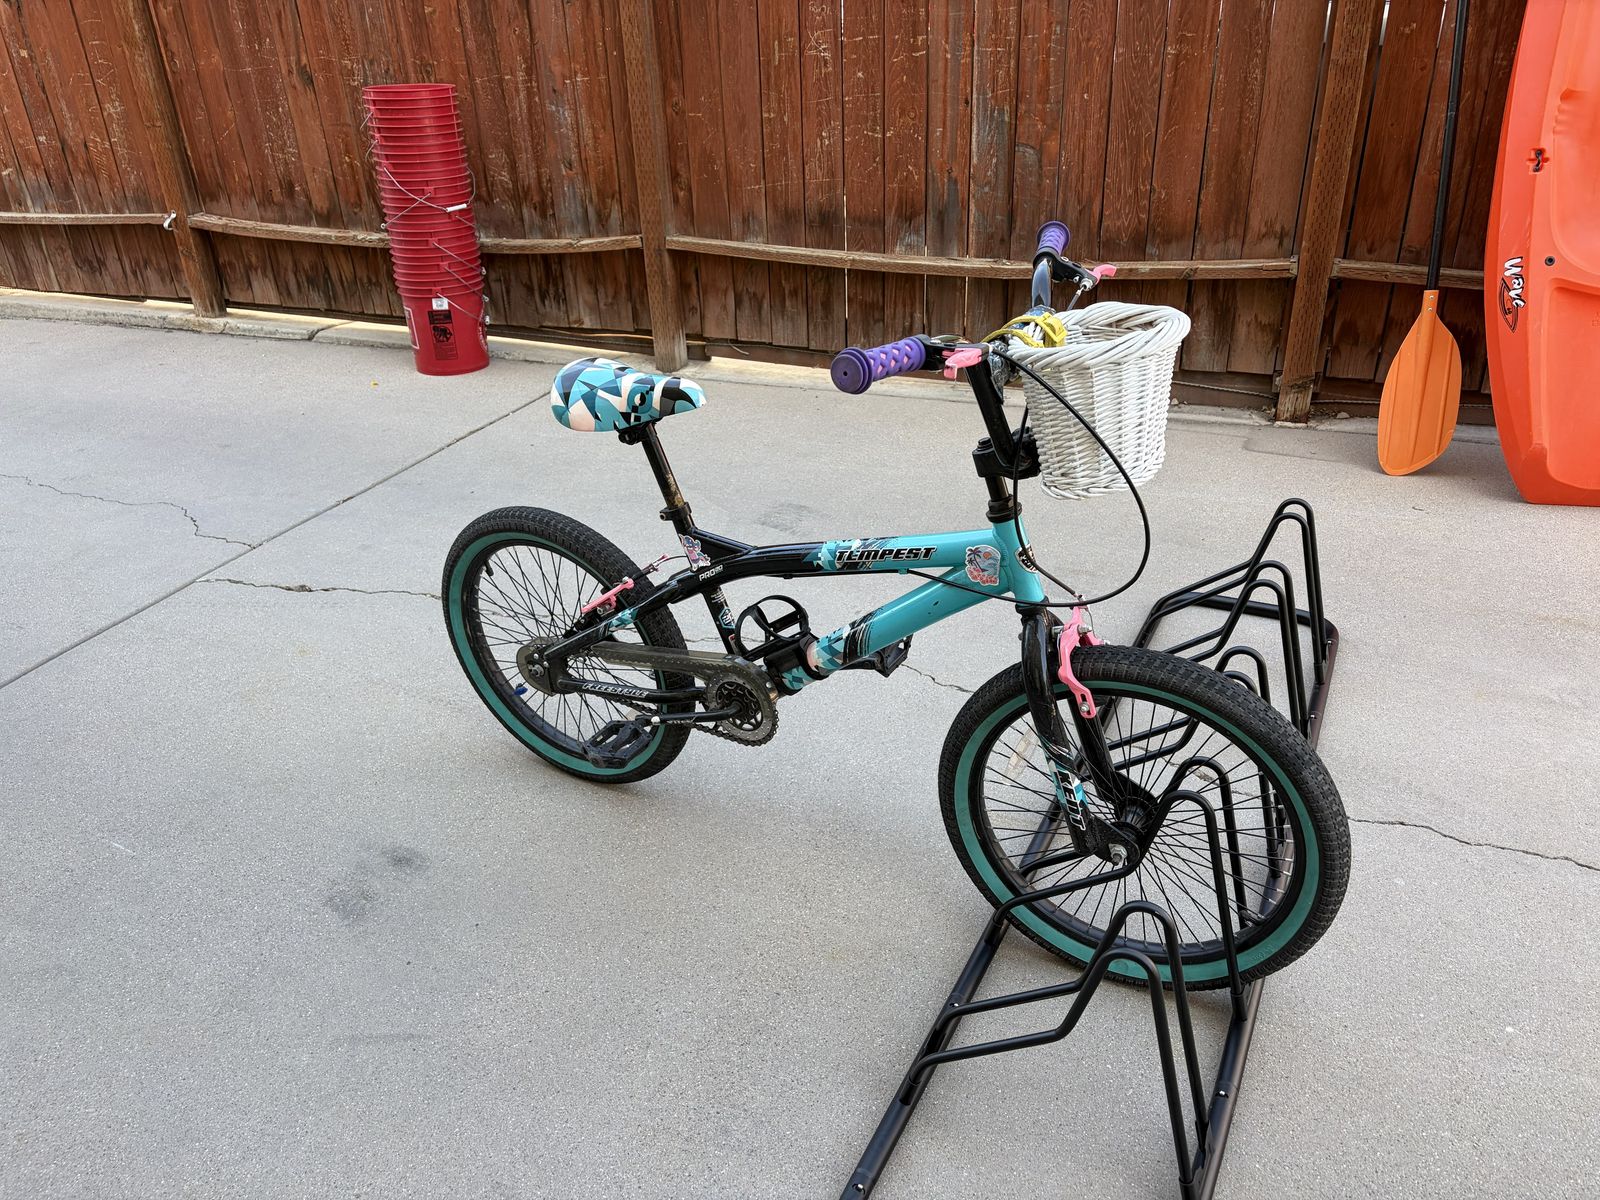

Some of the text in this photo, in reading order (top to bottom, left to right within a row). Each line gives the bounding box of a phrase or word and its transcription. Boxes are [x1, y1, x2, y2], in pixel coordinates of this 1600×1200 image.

[1504, 256, 1526, 309] Wave
[836, 546, 938, 564] TEMPEST
[1057, 769, 1087, 831] KENT
